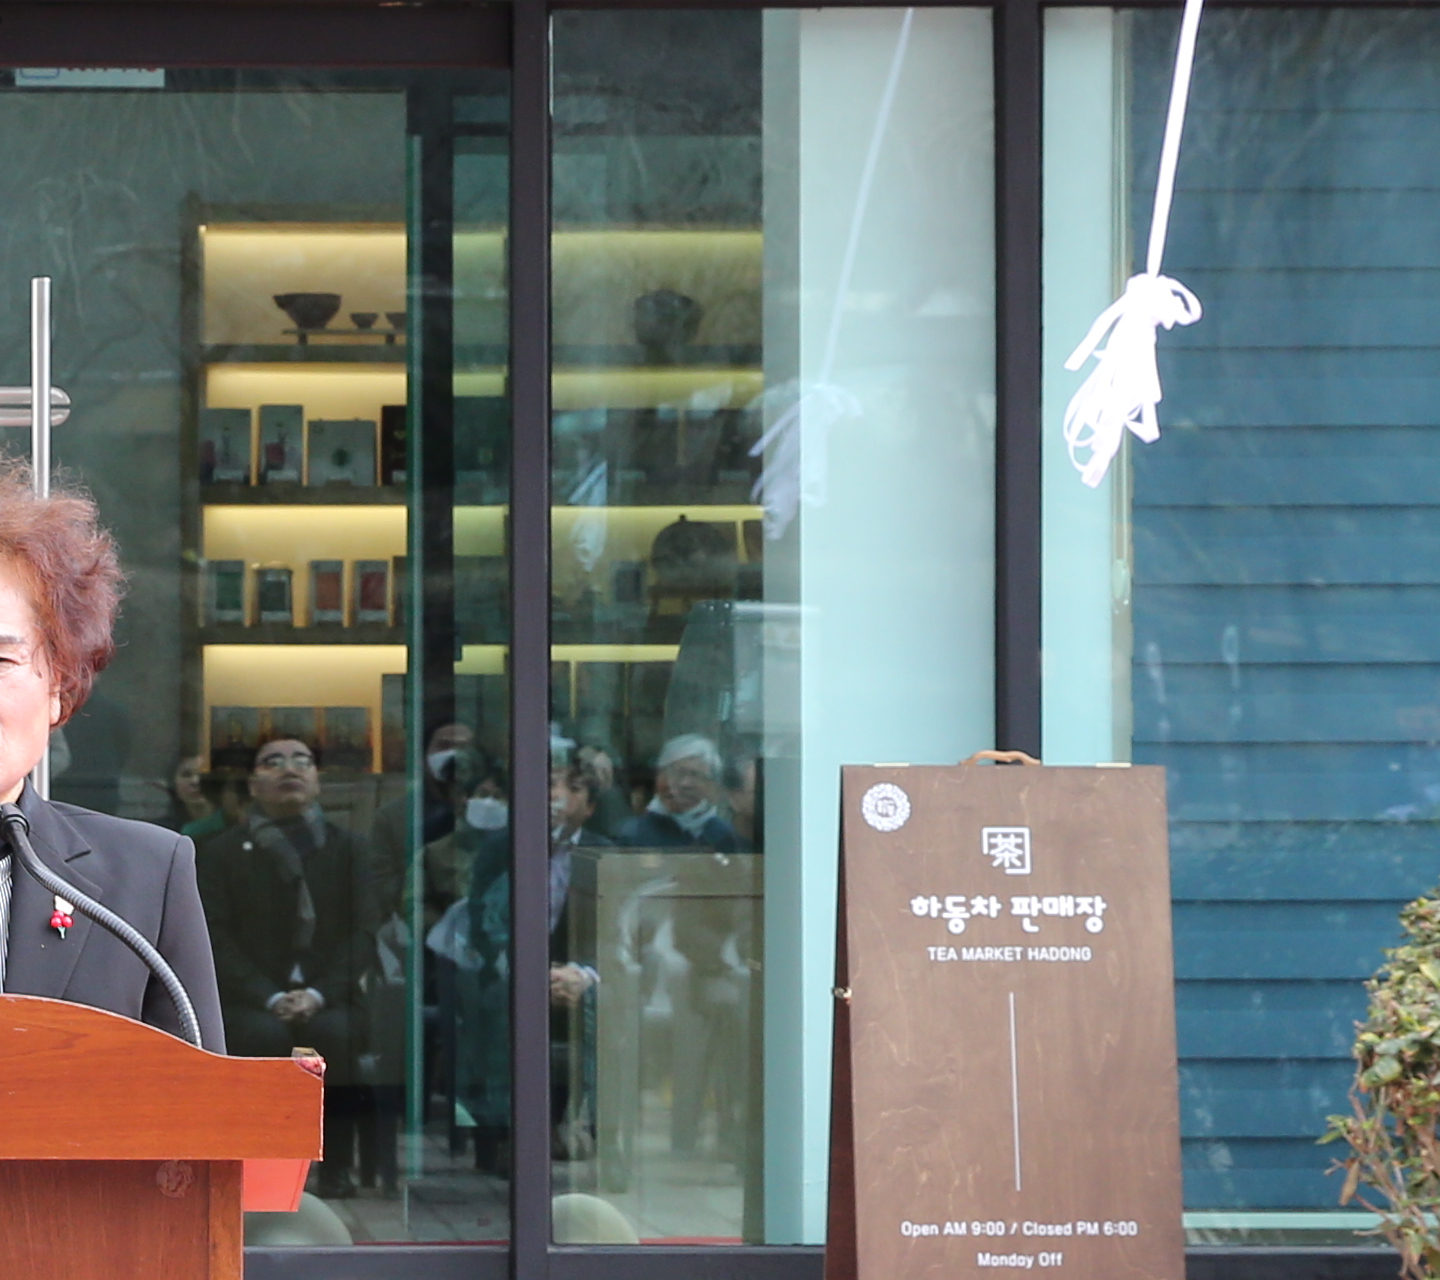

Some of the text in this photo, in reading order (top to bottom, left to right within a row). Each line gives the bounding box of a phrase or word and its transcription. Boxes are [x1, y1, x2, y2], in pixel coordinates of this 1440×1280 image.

[988, 832, 1024, 869] 茶
[909, 894, 1108, 935] 하동차 판매장
[927, 945, 1093, 962] TEA MARKET HADONG
[900, 1220, 940, 1238] Open
[942, 1220, 968, 1236] AM
[970, 1220, 1006, 1237] 9:00
[1021, 1220, 1073, 1237] Closed
[1075, 1220, 1100, 1236] PM
[1102, 1220, 1139, 1237] 6:00
[976, 1251, 1064, 1270] Monday Off
